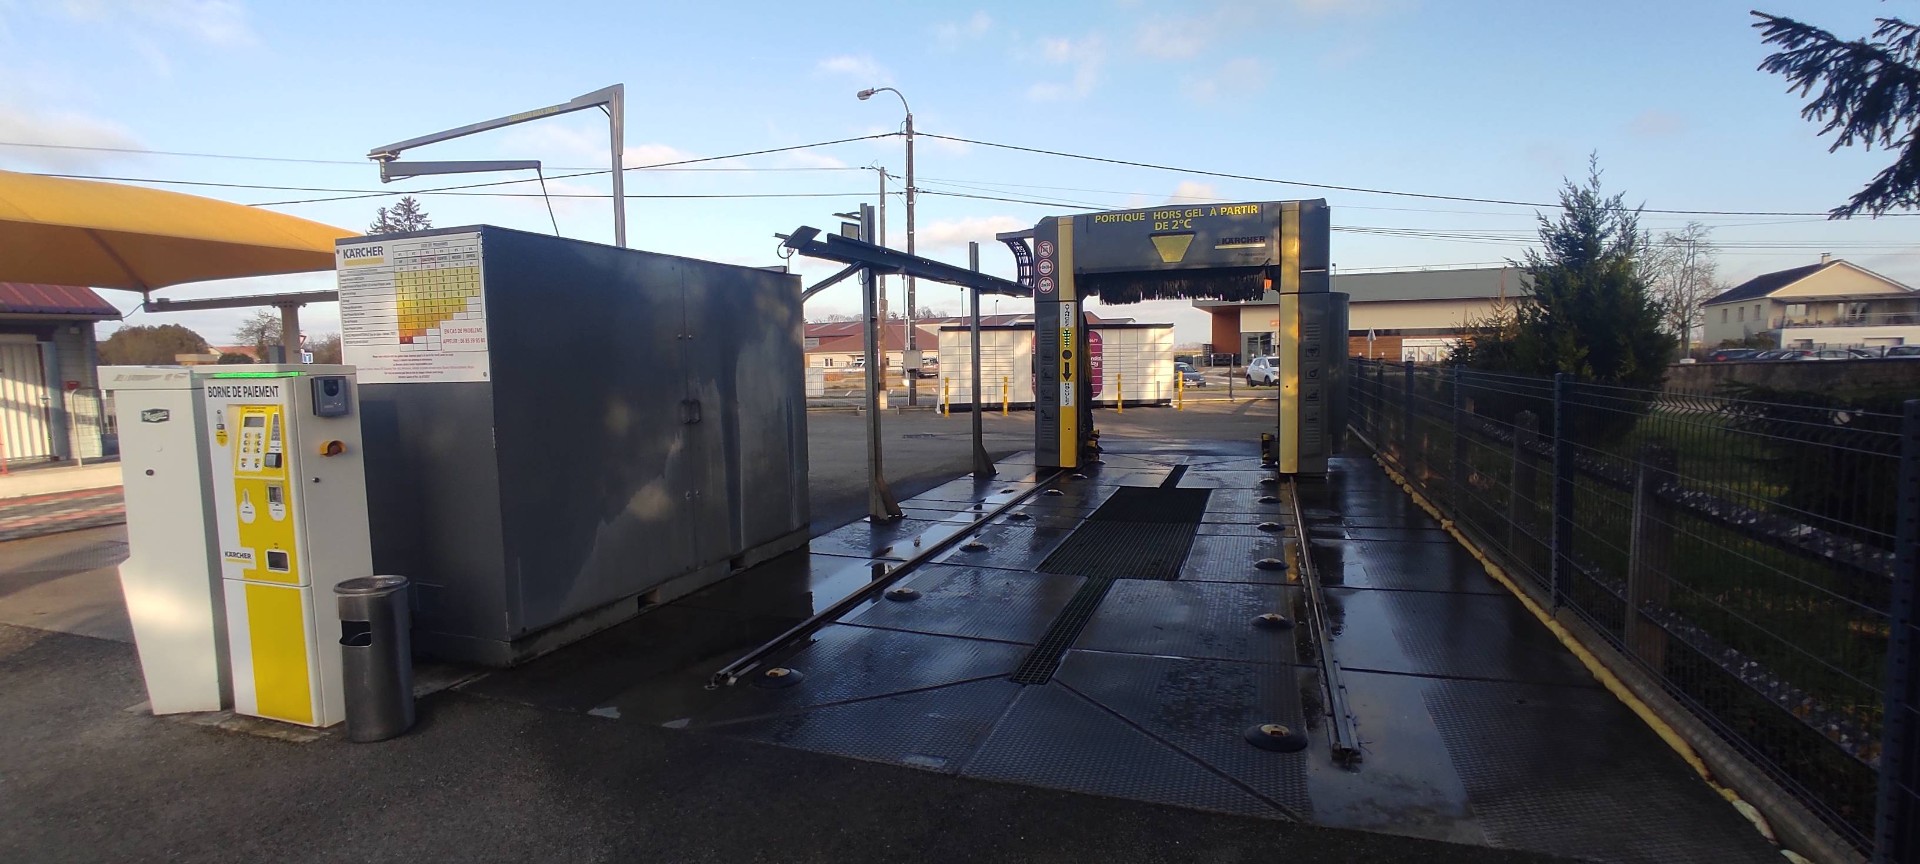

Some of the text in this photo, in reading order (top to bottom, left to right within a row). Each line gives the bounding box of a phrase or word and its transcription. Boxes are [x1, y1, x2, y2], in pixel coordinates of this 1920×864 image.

[1095, 204, 1258, 224] PORTIQUE HORS GEL À PARTIR
[1154, 219, 1192, 231] DE 2°C
[343, 246, 384, 259] KÄRCHER
[208, 386, 279, 398] BORNE DE PAIEMENT
[224, 551, 252, 559] KÄRCHER
